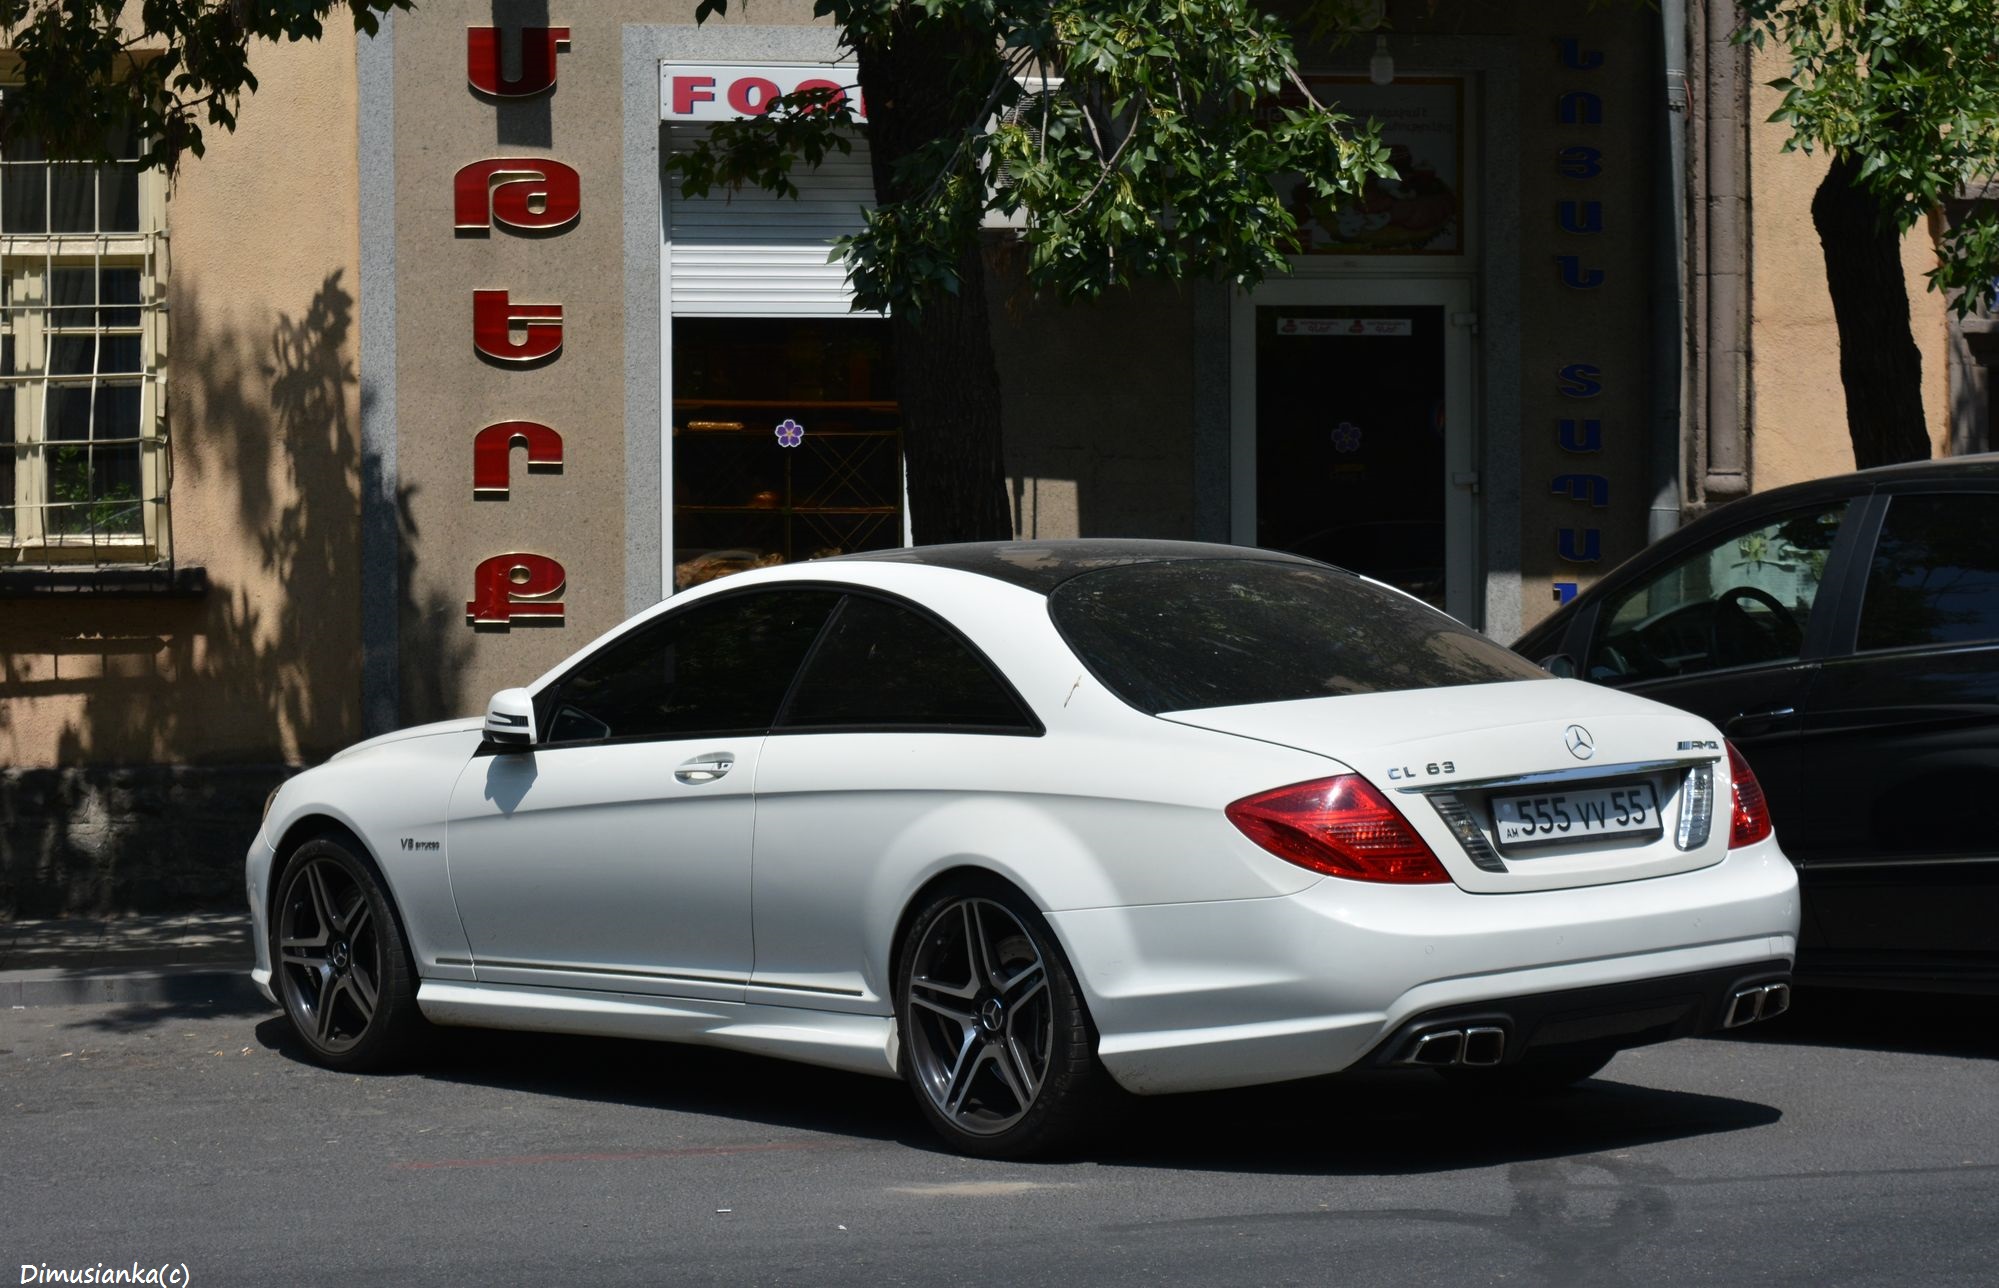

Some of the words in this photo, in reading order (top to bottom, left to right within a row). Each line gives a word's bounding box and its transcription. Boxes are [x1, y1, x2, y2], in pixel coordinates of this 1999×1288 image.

[672, 76, 867, 118] FOO
[1387, 766, 1416, 780] CL
[1426, 761, 1456, 776] 63
[1516, 796, 1572, 836] 555
[1575, 801, 1605, 830] VV
[1610, 790, 1647, 826] 55
[1506, 827, 1520, 839] AM
[400, 837, 415, 851] V8
